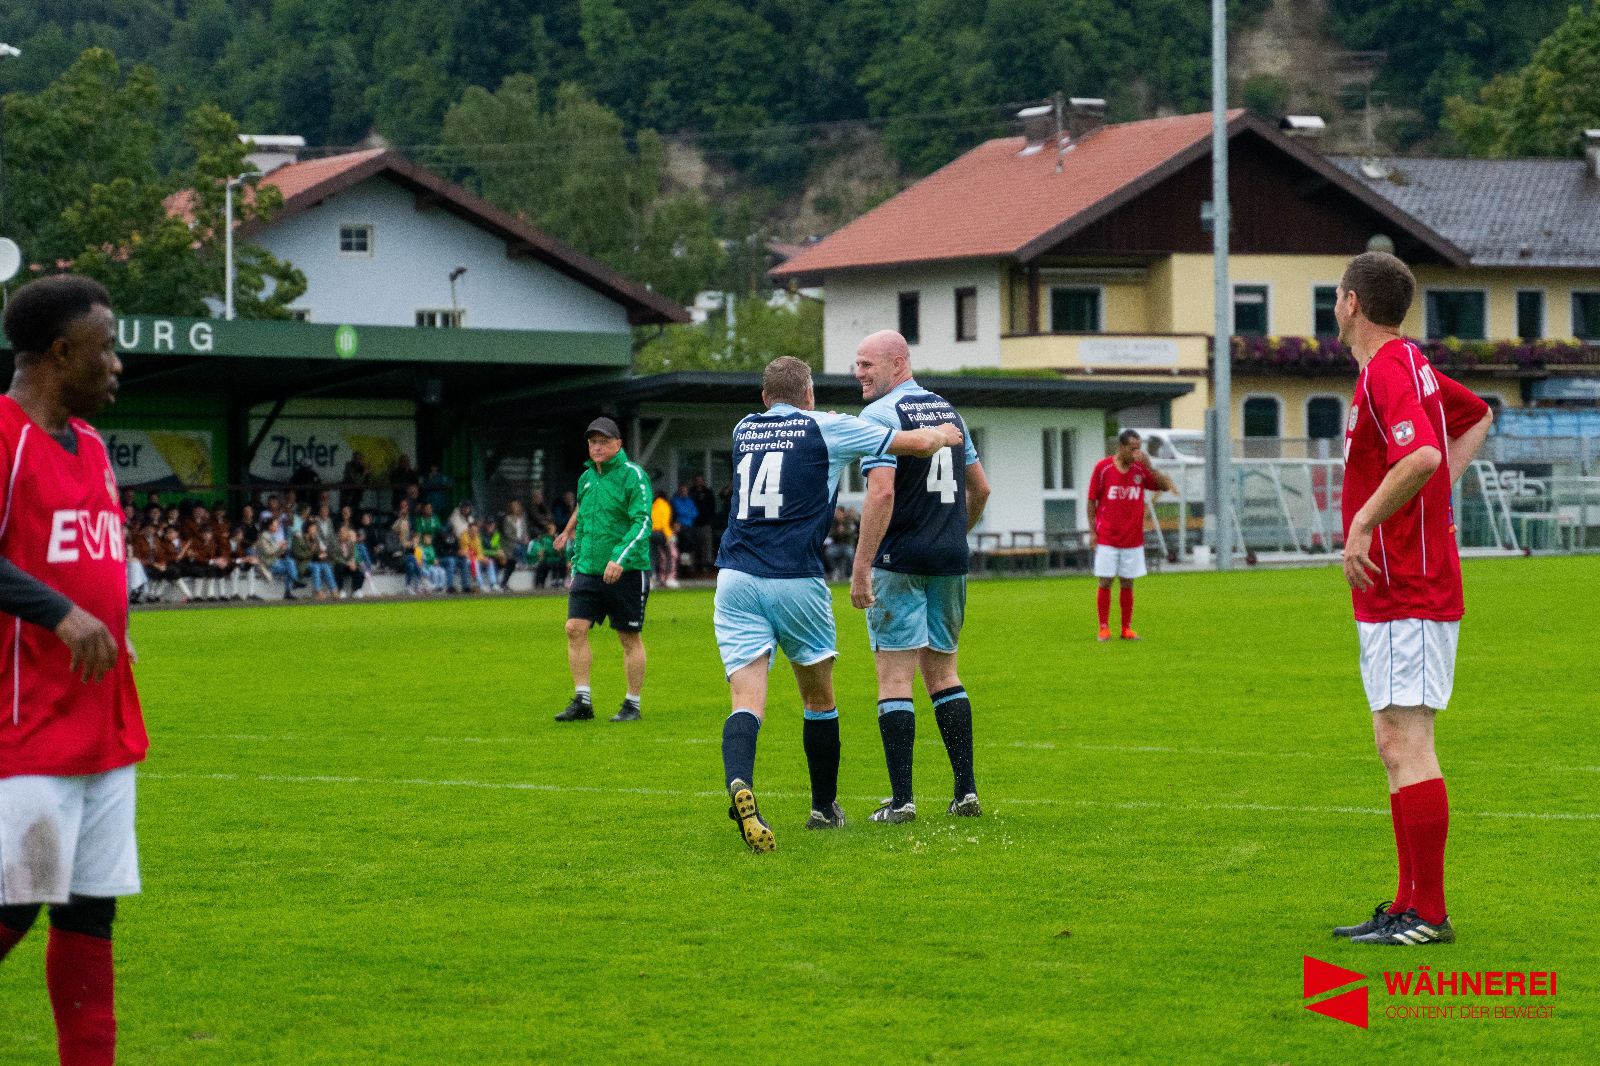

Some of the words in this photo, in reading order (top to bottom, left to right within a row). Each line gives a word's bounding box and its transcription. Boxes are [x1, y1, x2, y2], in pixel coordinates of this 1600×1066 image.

[908, 411, 957, 422] Fußball-Team
[736, 429, 806, 442] Fußball-Team
[739, 440, 794, 452] Österreich
[271, 435, 338, 475] Zipfer
[927, 446, 958, 504] 4
[737, 451, 784, 520] 14
[1108, 485, 1141, 500] EVN
